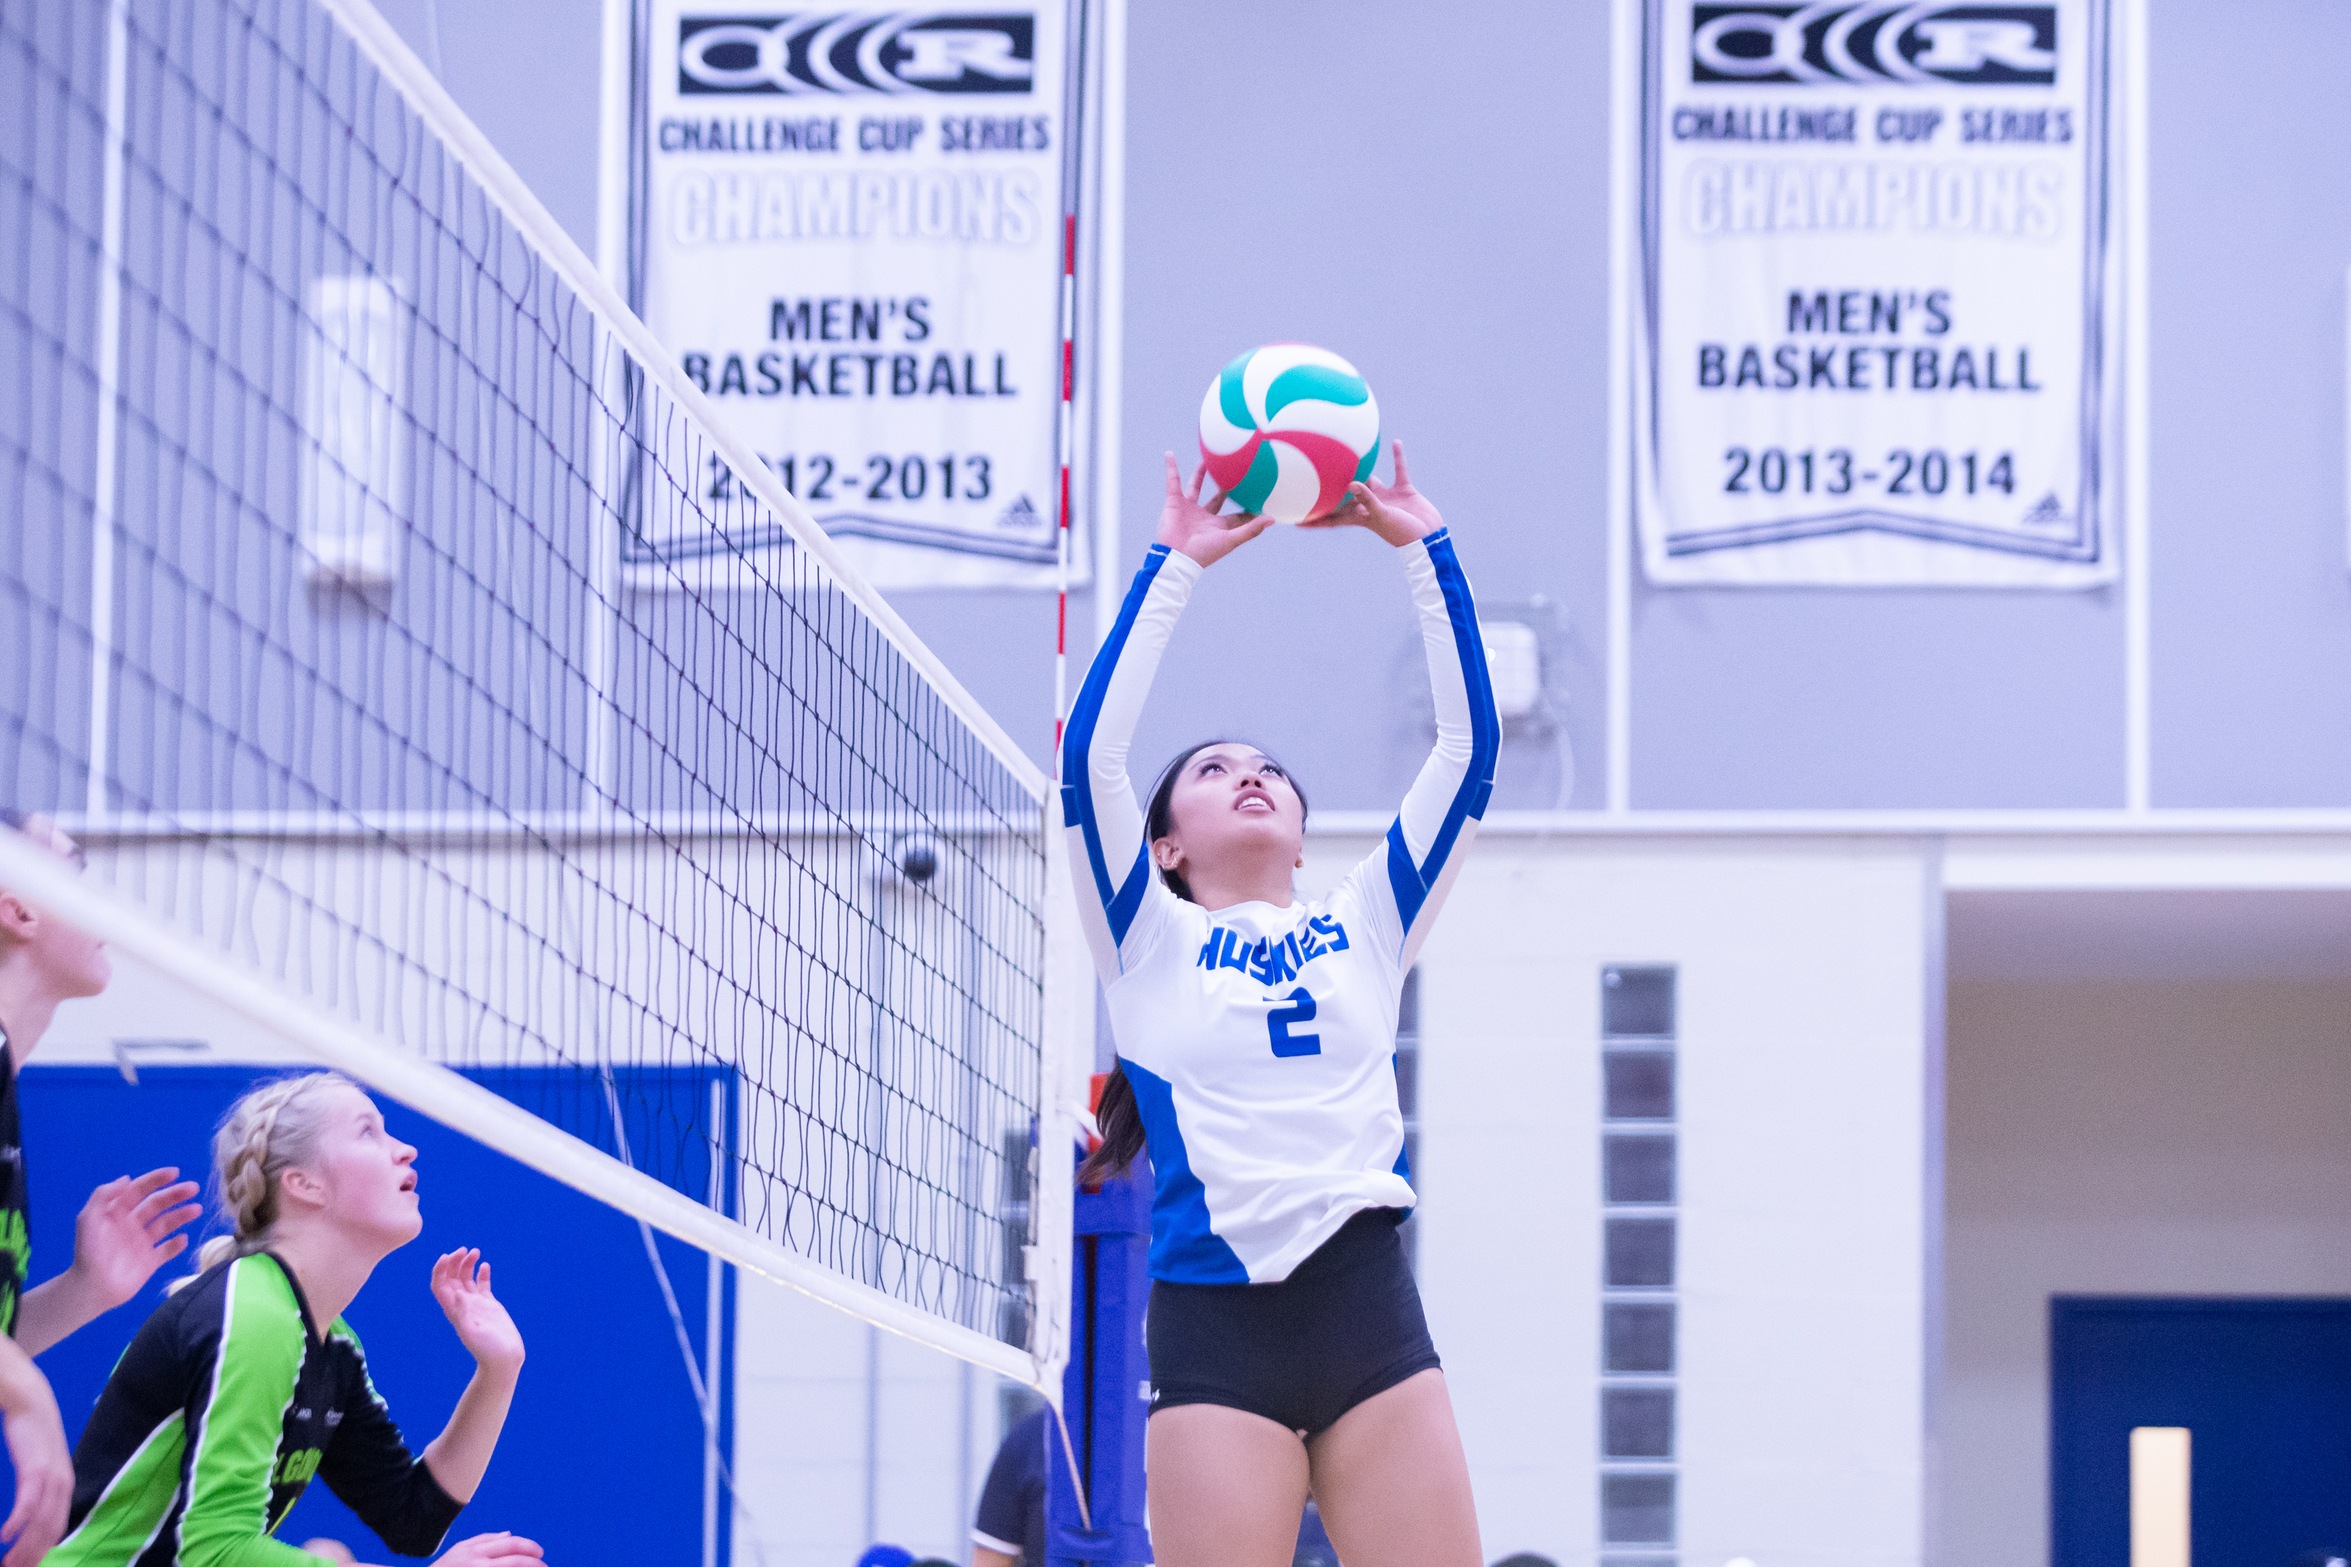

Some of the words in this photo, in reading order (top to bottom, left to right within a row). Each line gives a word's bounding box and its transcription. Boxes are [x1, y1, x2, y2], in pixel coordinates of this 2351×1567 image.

[658, 116, 840, 153] CHALLENGE
[857, 116, 925, 153] CUP
[940, 116, 1050, 153] SERIES
[1671, 106, 1857, 144] CHALLENGE
[1874, 106, 1945, 144] CUP
[1960, 107, 2074, 145] SERIES
[668, 168, 1040, 248] CHAMPIONS
[1684, 159, 2065, 248] CHAMPIONS
[769, 297, 931, 343] MEN'S
[1786, 290, 1952, 337] MEN'S
[683, 352, 1016, 398] BASKETBALL
[1697, 345, 2040, 392] BASKETBALL
[707, 454, 992, 500] 212-2013
[1723, 447, 2016, 496] 2013-2014
[1197, 914, 1350, 987] HUSKIES
[1263, 987, 1321, 1058] 2
